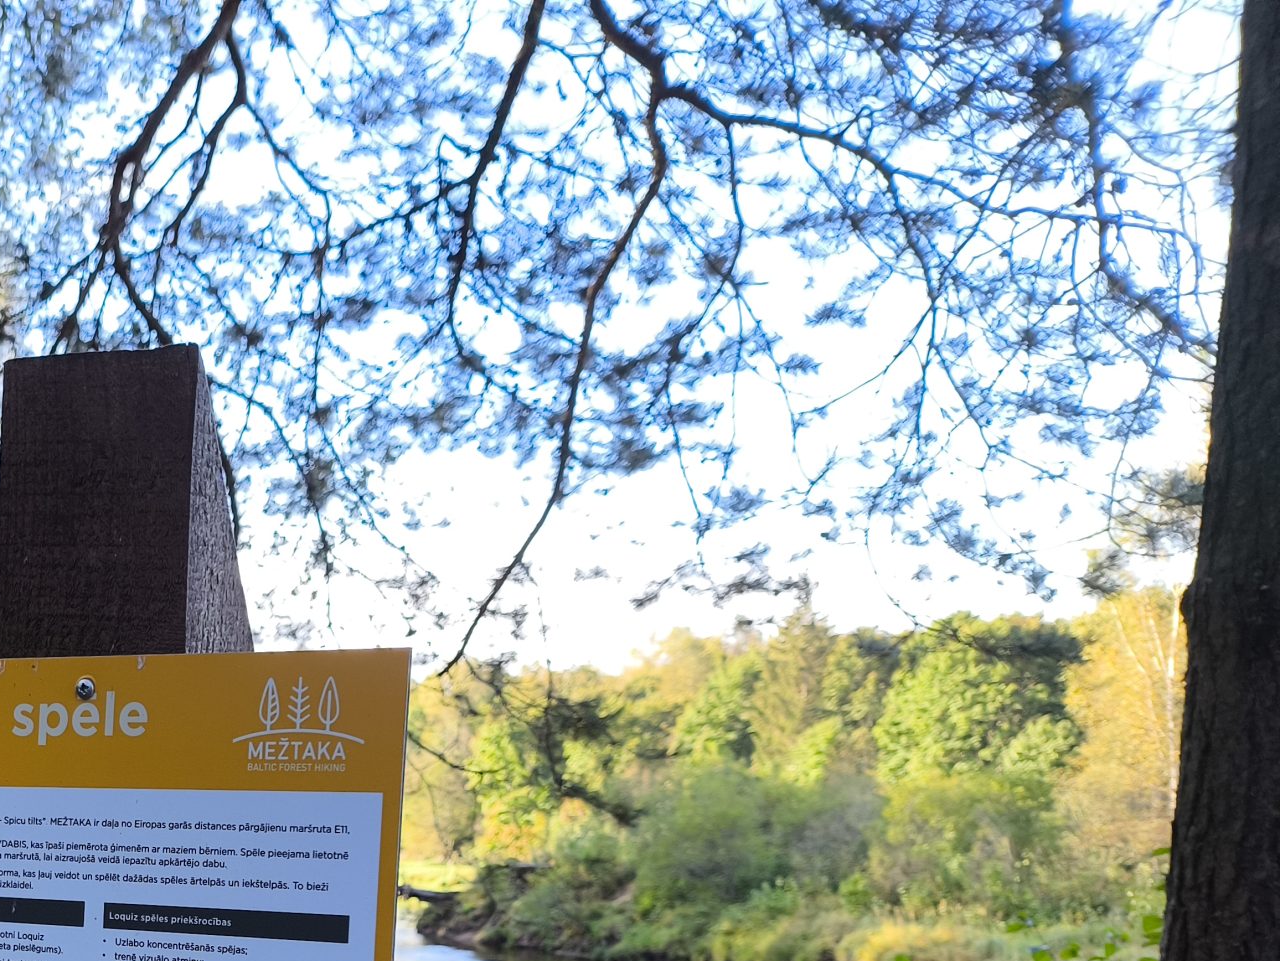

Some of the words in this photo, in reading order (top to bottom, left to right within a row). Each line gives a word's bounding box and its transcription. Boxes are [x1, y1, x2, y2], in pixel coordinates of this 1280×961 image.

[247, 737, 346, 761] MEŽTAKA
[247, 762, 278, 772] BALTIC
[278, 762, 313, 772] FOREST
[313, 763, 346, 773] HIKING
[3, 815, 26, 826] Spicu
[49, 816, 92, 827] MEŽTAKA
[93, 818, 100, 827] ir
[101, 818, 120, 830] daļa
[120, 820, 133, 828] no
[133, 819, 167, 830] Eiropas
[167, 820, 193, 831] garās
[193, 821, 237, 832] distances
[238, 822, 288, 834] pārgājienu
[289, 824, 332, 834] maršruta
[108, 911, 139, 922] Loquiz
[140, 913, 169, 924] spēles
[170, 915, 232, 927] priekšrocības
[114, 937, 145, 948] Uzlabo
[146, 939, 215, 953] koncentrēšanās
[217, 944, 248, 956] spējas;
[114, 951, 137, 961] trenē
